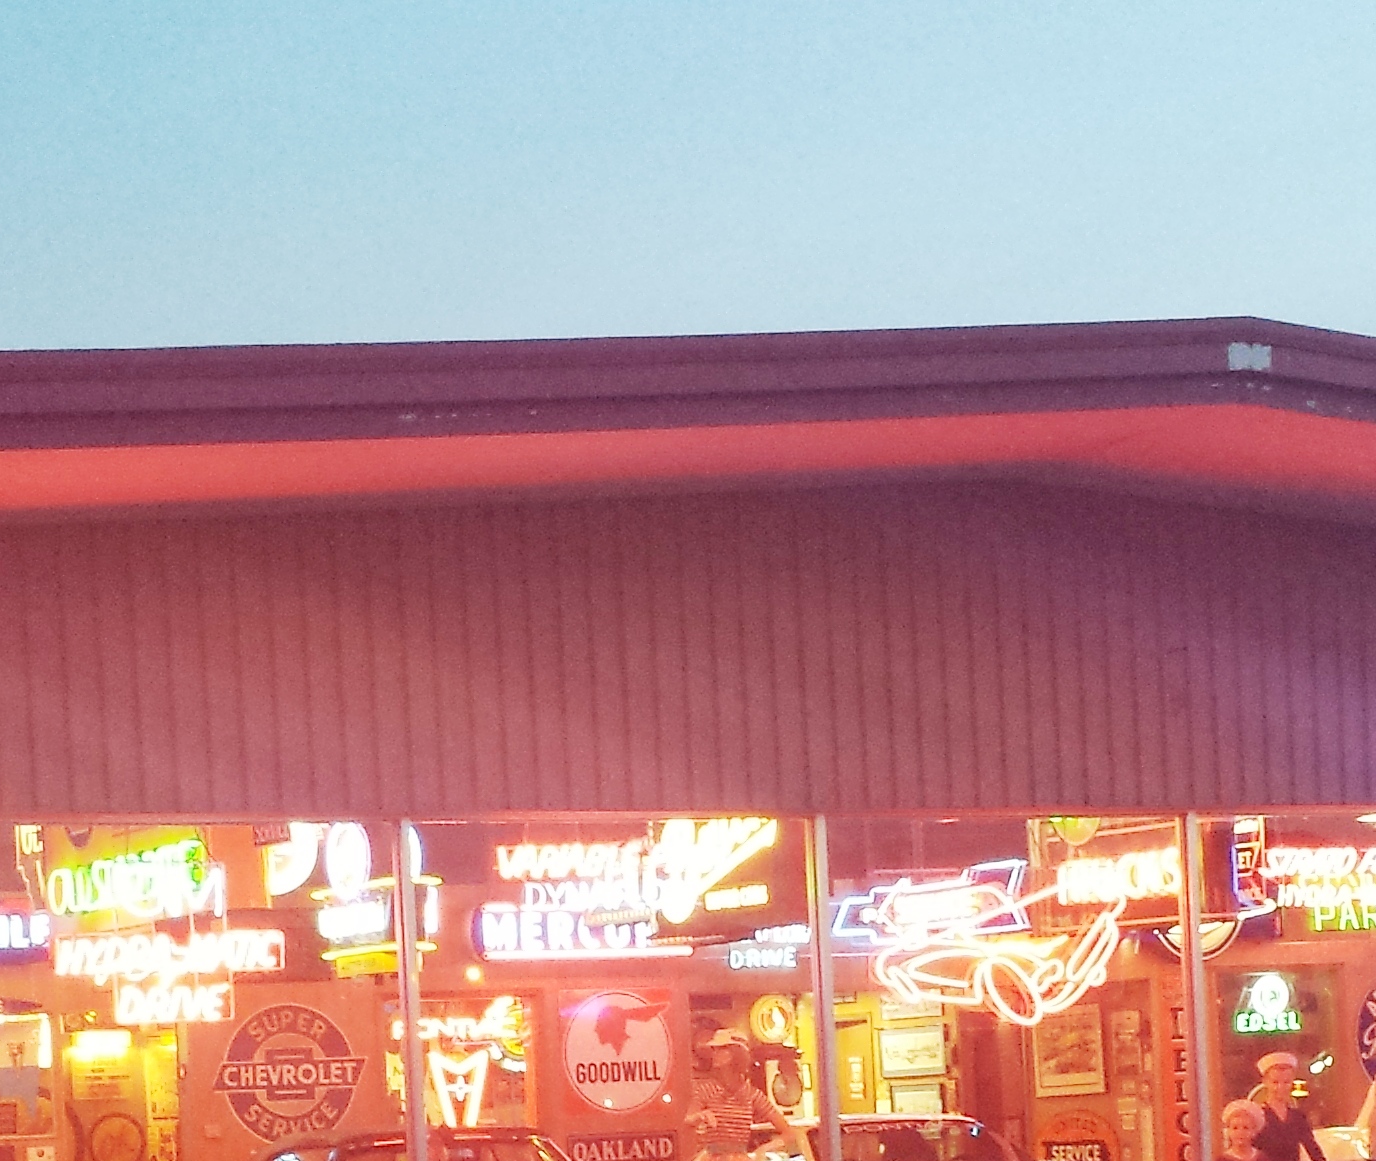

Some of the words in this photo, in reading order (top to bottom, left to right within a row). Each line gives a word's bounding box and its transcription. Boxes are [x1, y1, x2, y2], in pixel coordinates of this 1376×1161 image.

[729, 946, 798, 970] DRIVE
[247, 1010, 327, 1042] SUPER
[1234, 1012, 1302, 1033] EDSEL
[223, 1062, 357, 1088] CHEVROLET
[575, 1060, 662, 1084] GOODWILL
[243, 1101, 339, 1138] SERVICE
[572, 1137, 674, 1161] OAKLAND
